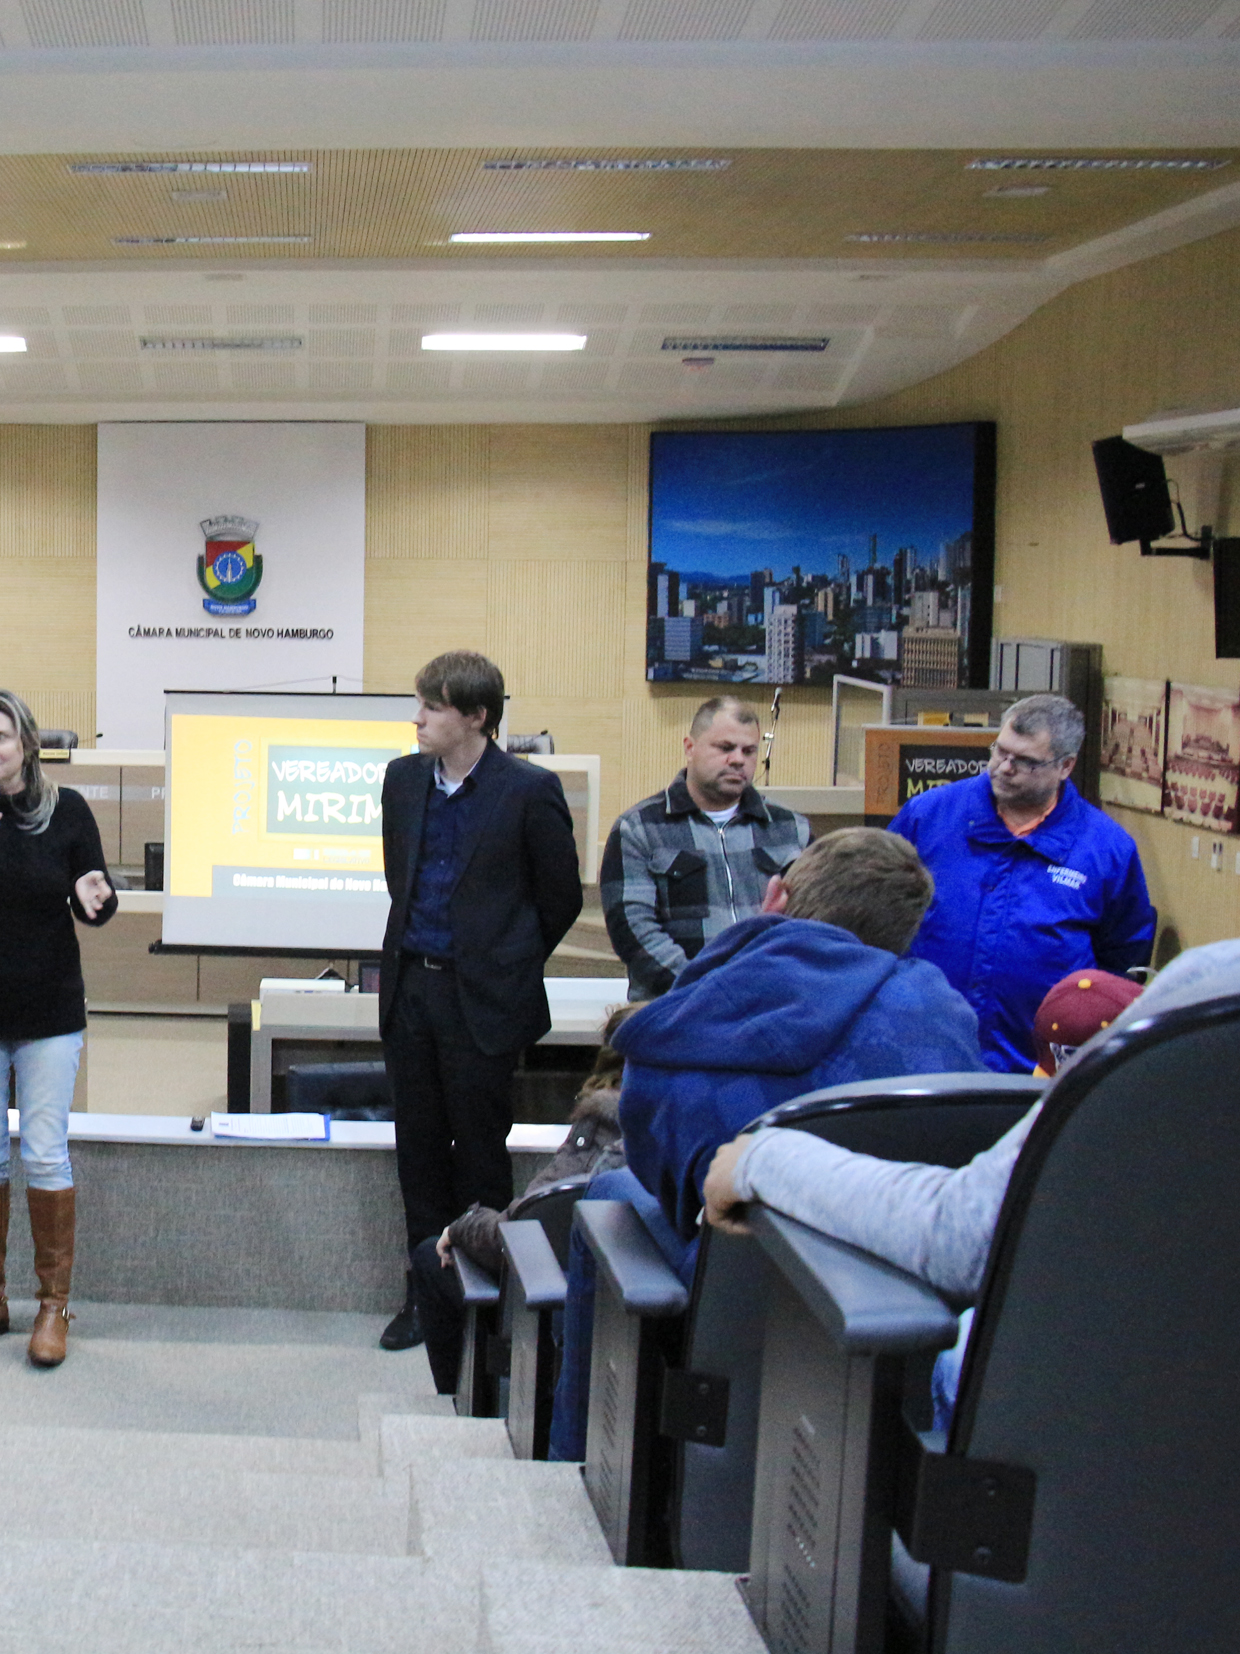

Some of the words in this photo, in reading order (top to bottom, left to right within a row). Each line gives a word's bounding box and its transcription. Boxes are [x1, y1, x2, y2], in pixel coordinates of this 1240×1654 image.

[128, 624, 173, 639] CÂMARA
[175, 627, 226, 639] MUNICIPAL
[229, 628, 242, 639] DE
[246, 628, 275, 639] NOVO
[277, 628, 334, 640] HAMBURGO
